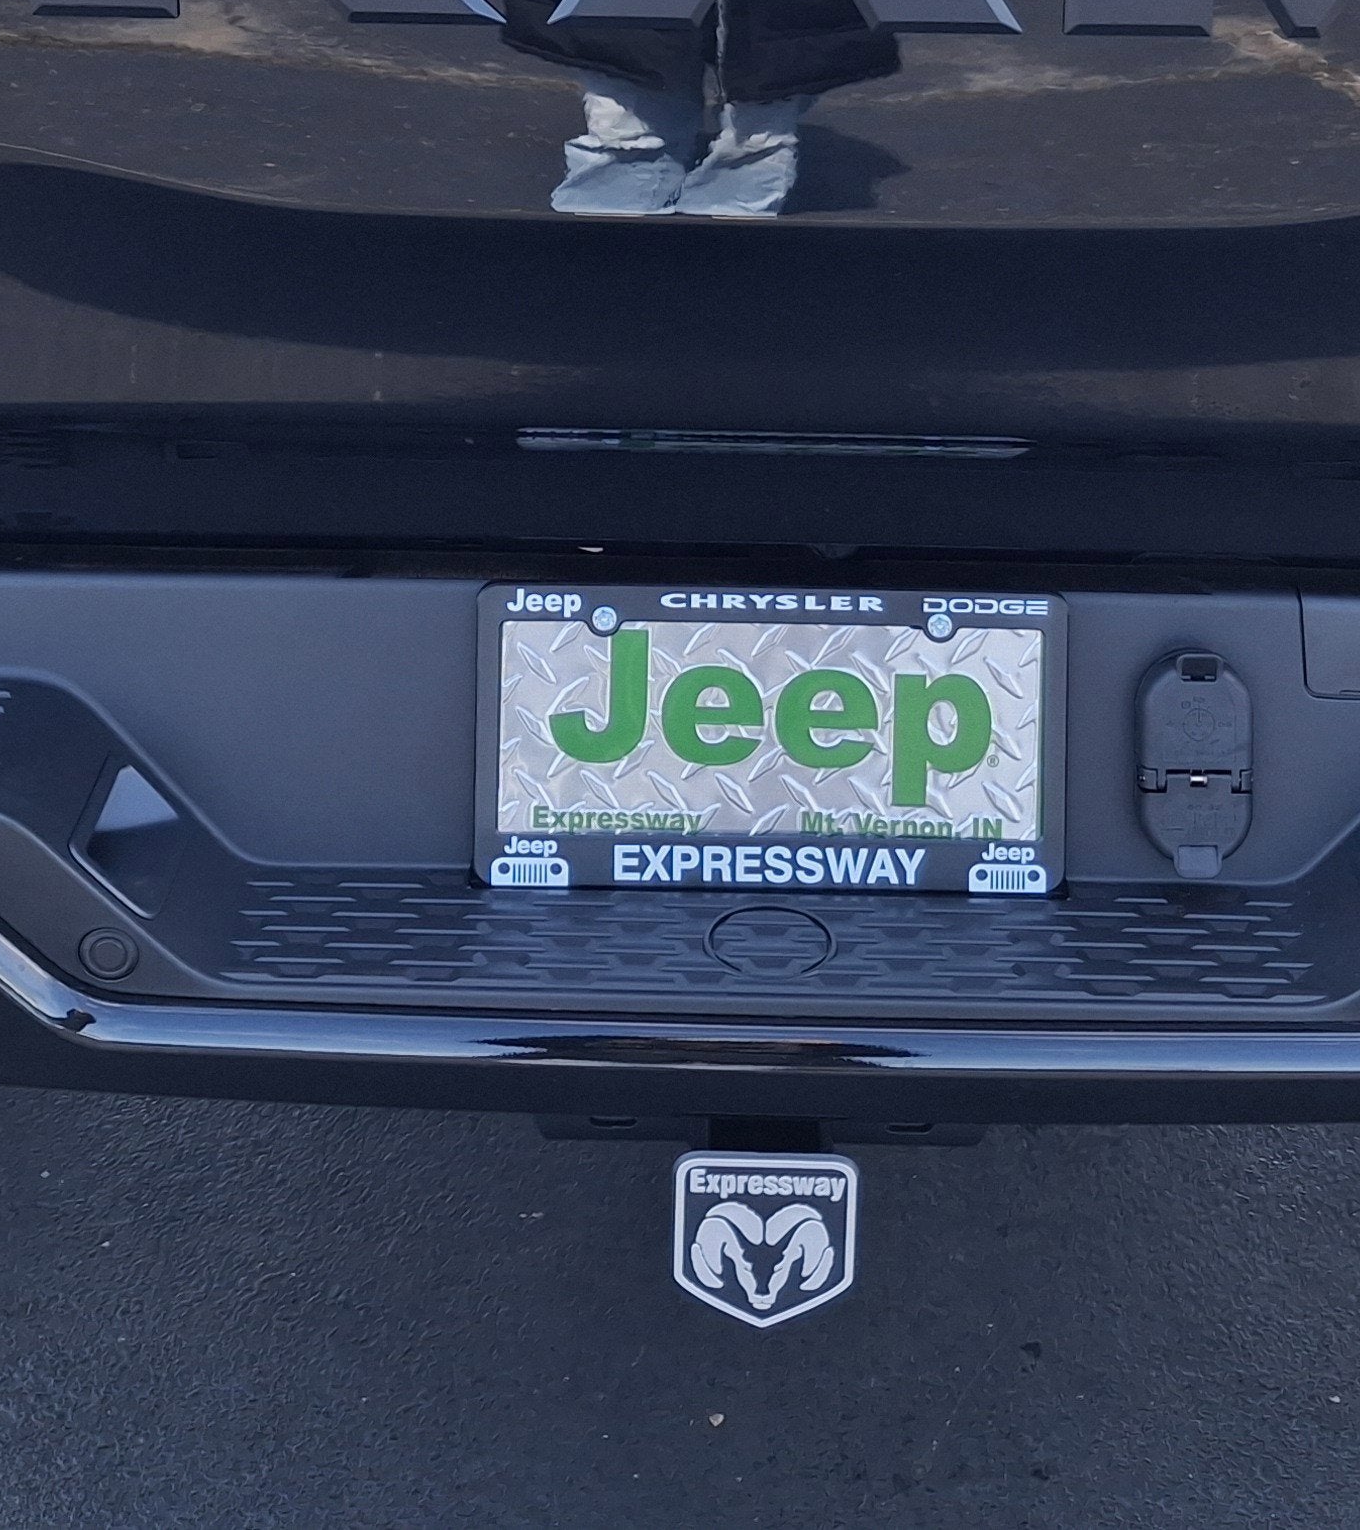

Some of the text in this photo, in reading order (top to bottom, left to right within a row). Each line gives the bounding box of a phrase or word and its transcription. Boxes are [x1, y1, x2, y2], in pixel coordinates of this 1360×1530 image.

[506, 588, 582, 618] Jeep
[660, 592, 884, 612] CHRYSLER
[922, 597, 1049, 616] DODGE
[549, 628, 993, 807] Jeep
[532, 804, 702, 835] Expressway
[972, 816, 1003, 840] IN
[503, 835, 558, 858] Jeep
[981, 842, 1035, 865] Jeep
[613, 844, 926, 886] EXPRESSWAY
[689, 1168, 847, 1202] Expressway
